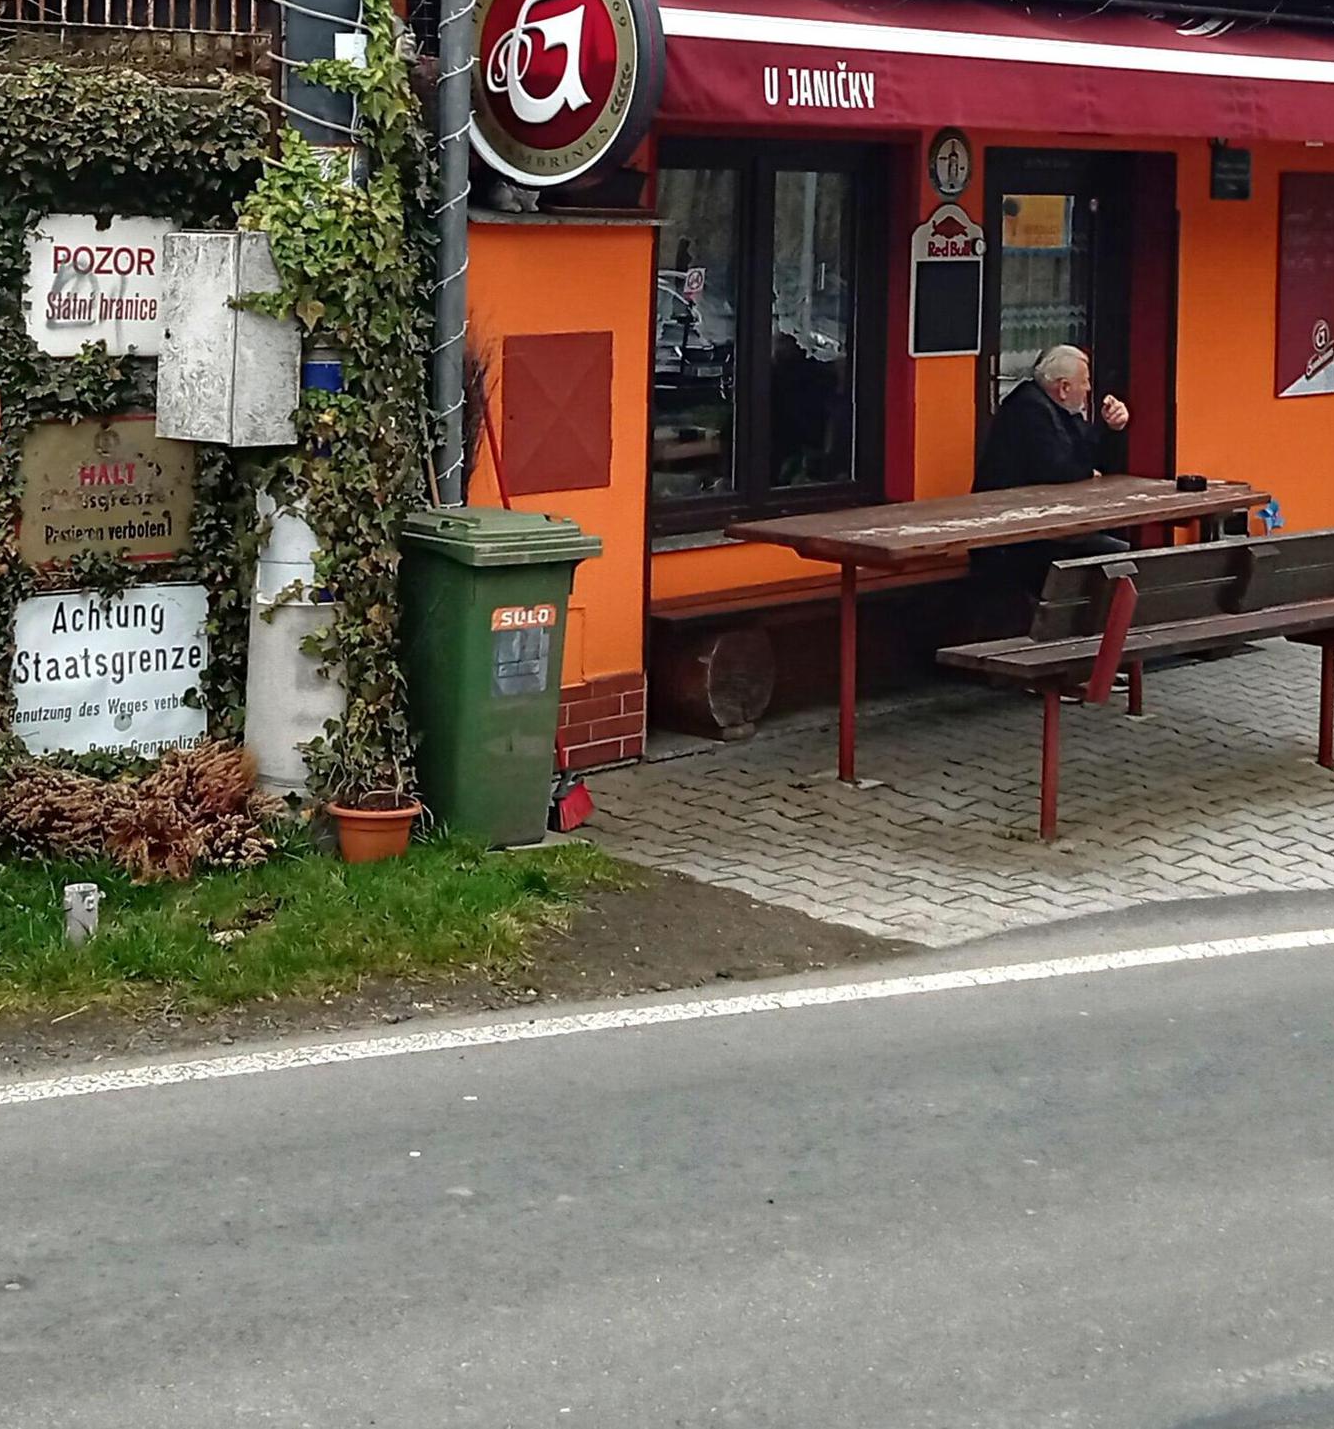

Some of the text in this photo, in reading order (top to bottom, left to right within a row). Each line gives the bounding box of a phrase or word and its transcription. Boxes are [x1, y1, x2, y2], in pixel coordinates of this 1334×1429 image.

[764, 60, 875, 109] U JANIČKY
[53, 245, 156, 276] POZOR
[46, 291, 158, 321] Státní hranice
[79, 463, 136, 487] HALT
[51, 599, 165, 634] Achtung
[500, 608, 550, 626] SULO
[13, 644, 202, 684] Staatsgrenze
[8, 692, 200, 723] Benutzung des Weges verbo
